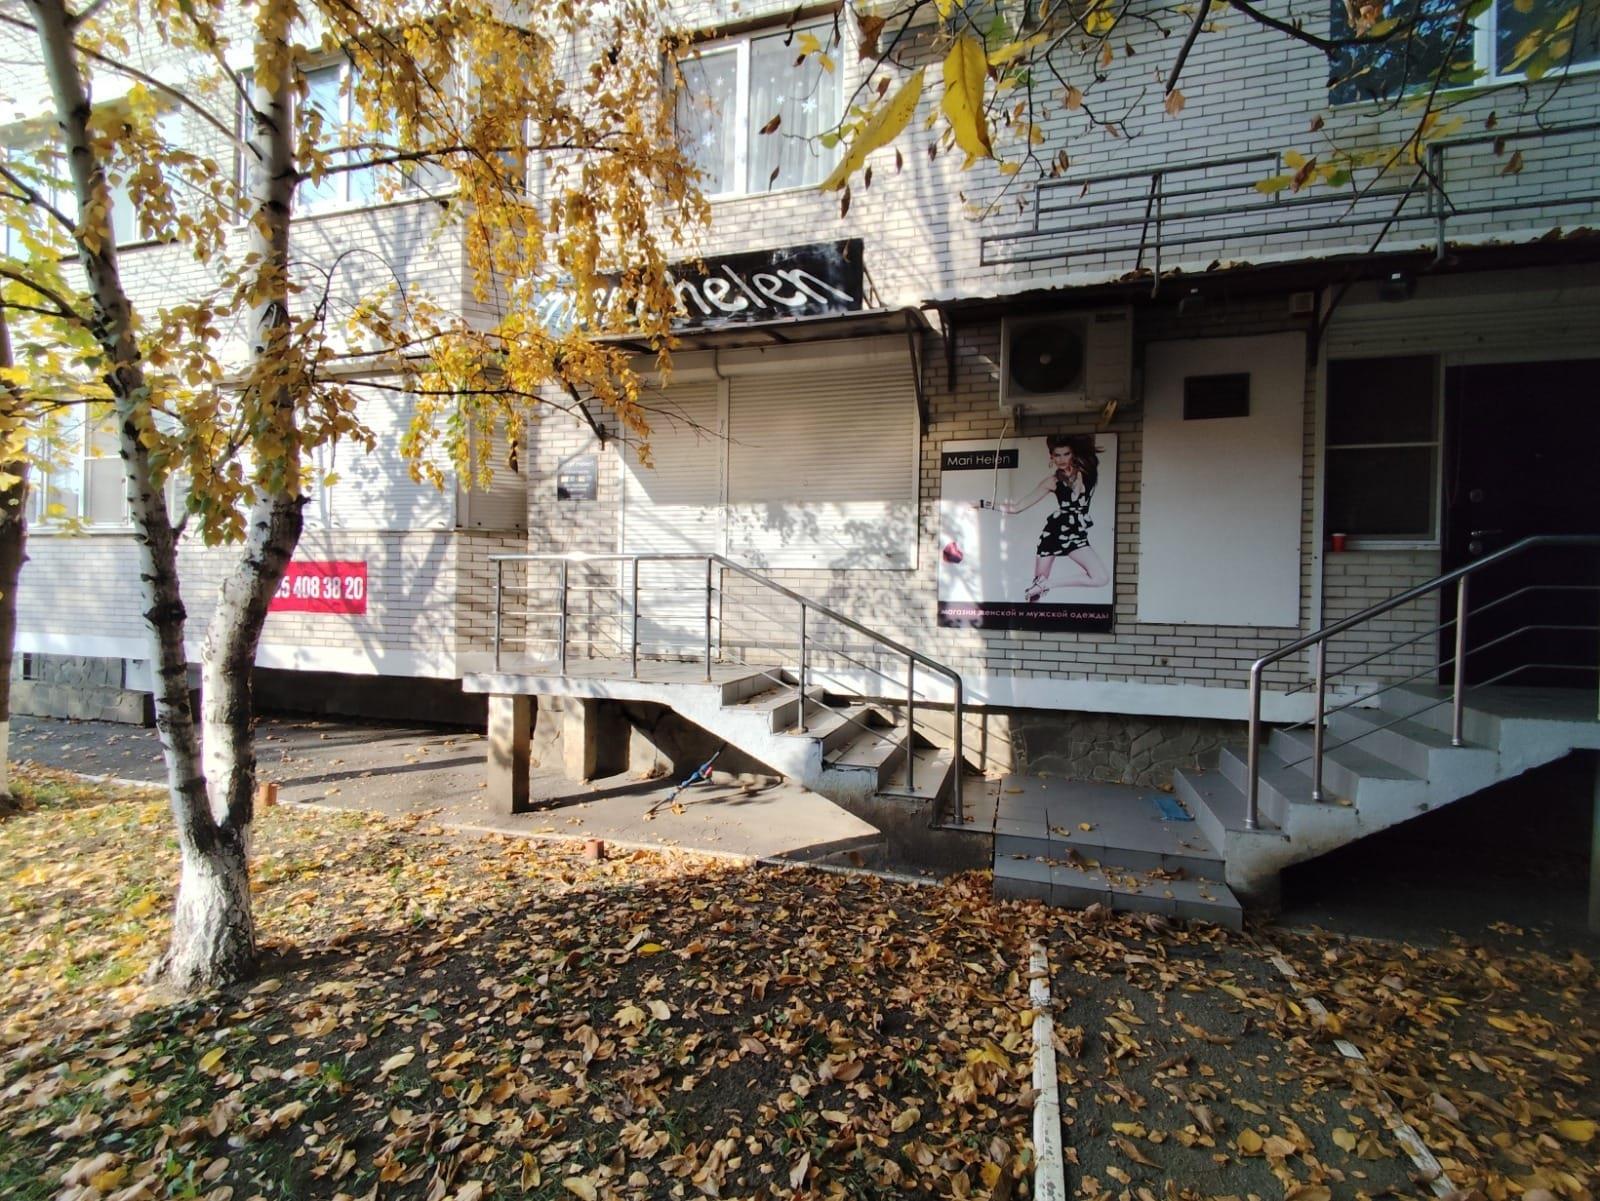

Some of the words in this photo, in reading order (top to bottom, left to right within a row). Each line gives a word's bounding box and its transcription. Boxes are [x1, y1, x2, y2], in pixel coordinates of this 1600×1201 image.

[663, 264, 854, 315] helen
[947, 456, 973, 466] Mari
[976, 454, 1010, 465] Helen
[293, 575, 320, 598] 408
[323, 576, 341, 600] 38
[344, 576, 363, 600] 20
[977, 609, 1017, 617] женской
[1026, 610, 1068, 618] мужской
[1070, 612, 1109, 621] одежды
